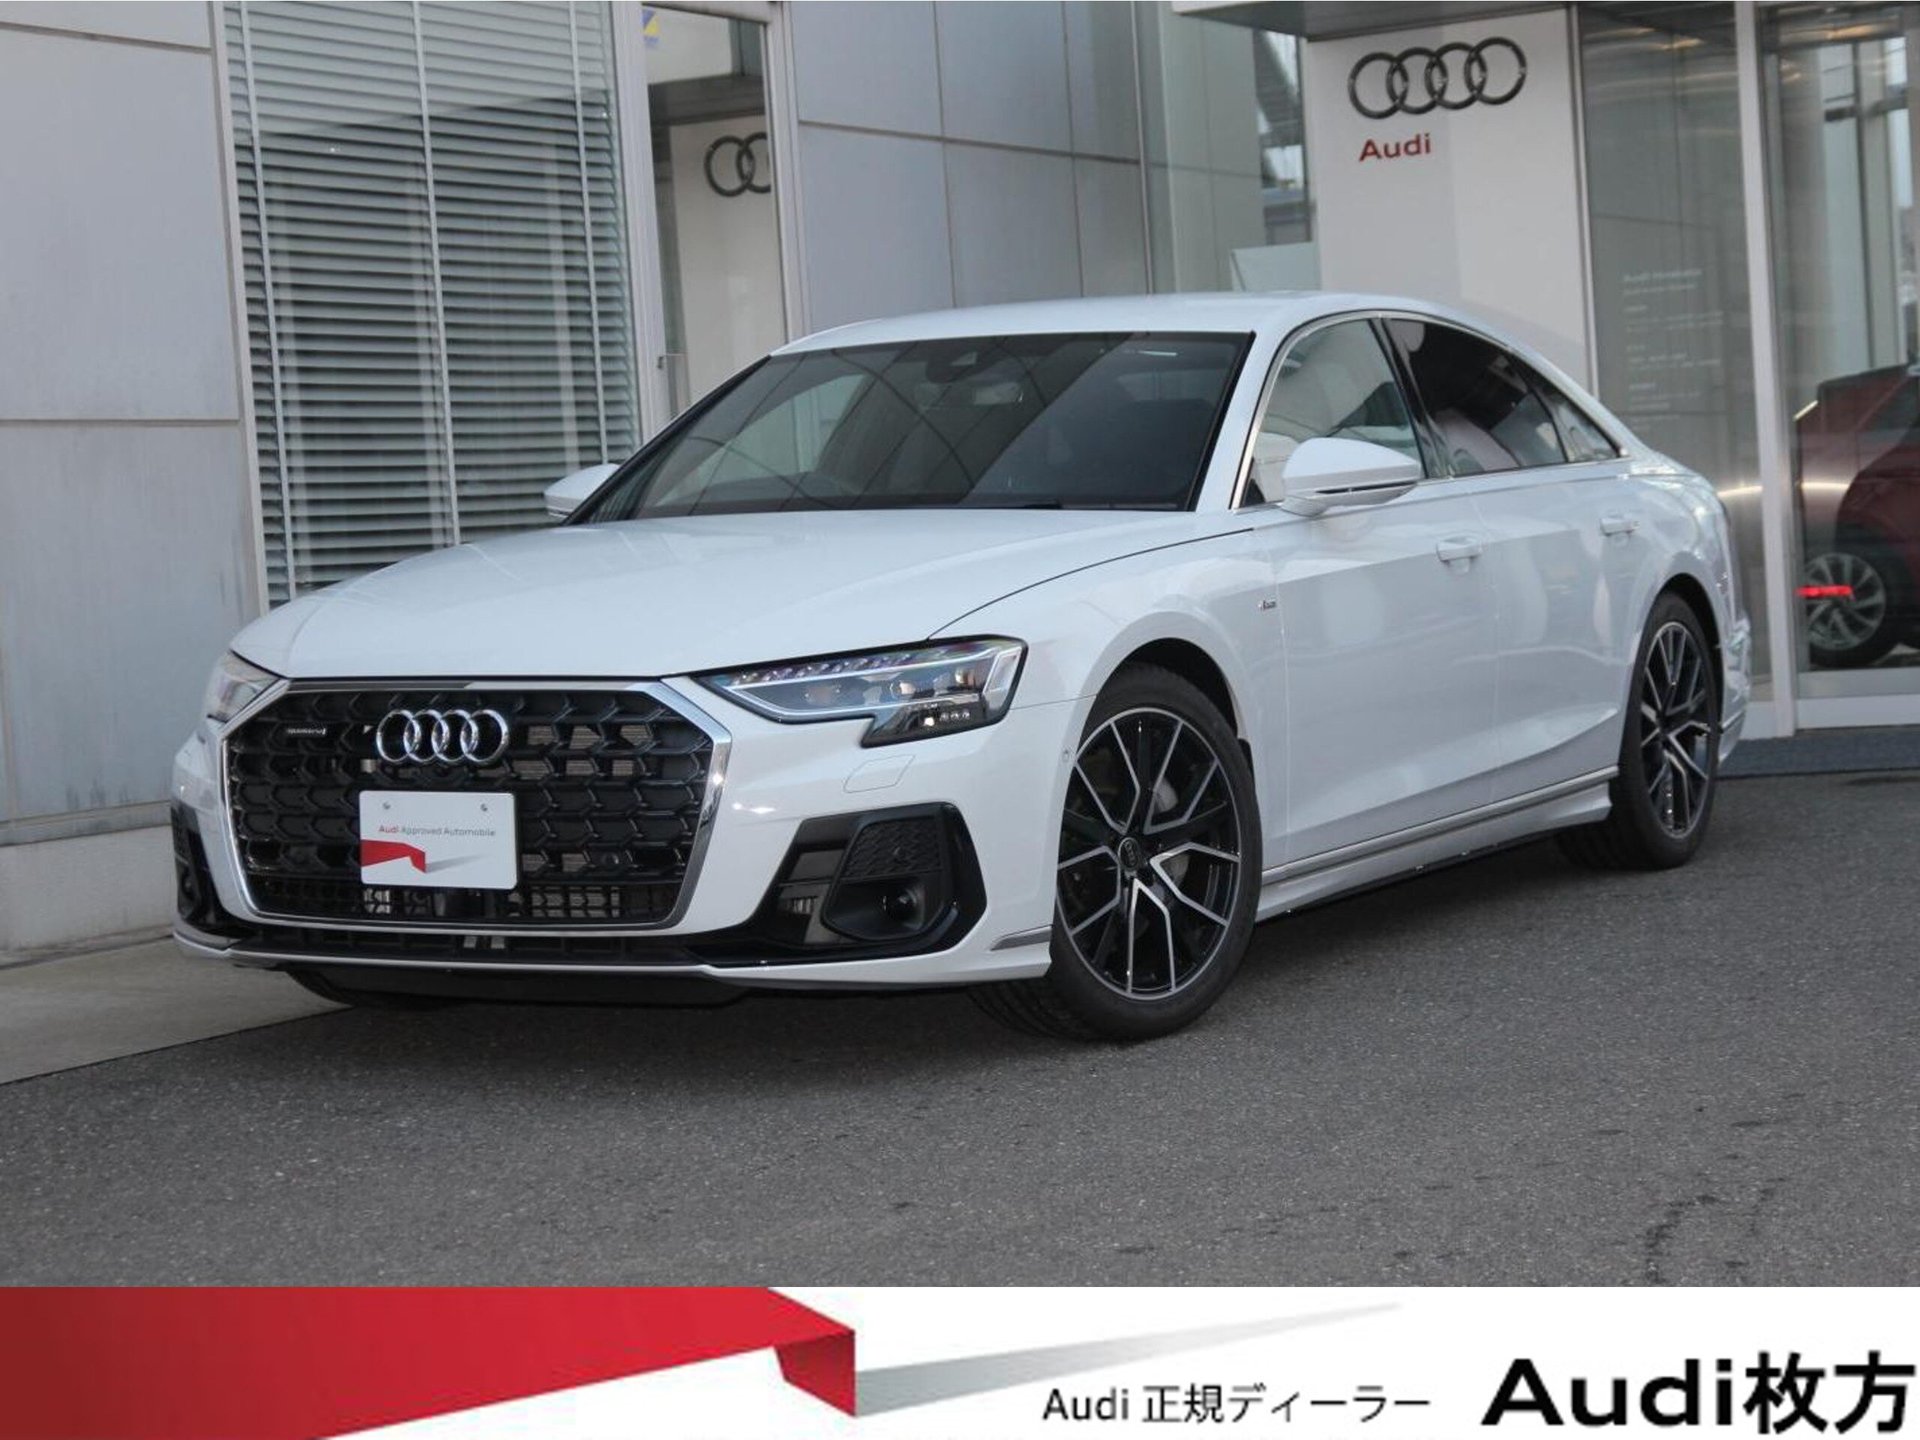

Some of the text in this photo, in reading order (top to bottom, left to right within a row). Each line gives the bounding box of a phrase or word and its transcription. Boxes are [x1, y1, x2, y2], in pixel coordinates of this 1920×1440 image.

[1359, 133, 1431, 162] Audi
[379, 825, 496, 837] Audi Approved Automobile
